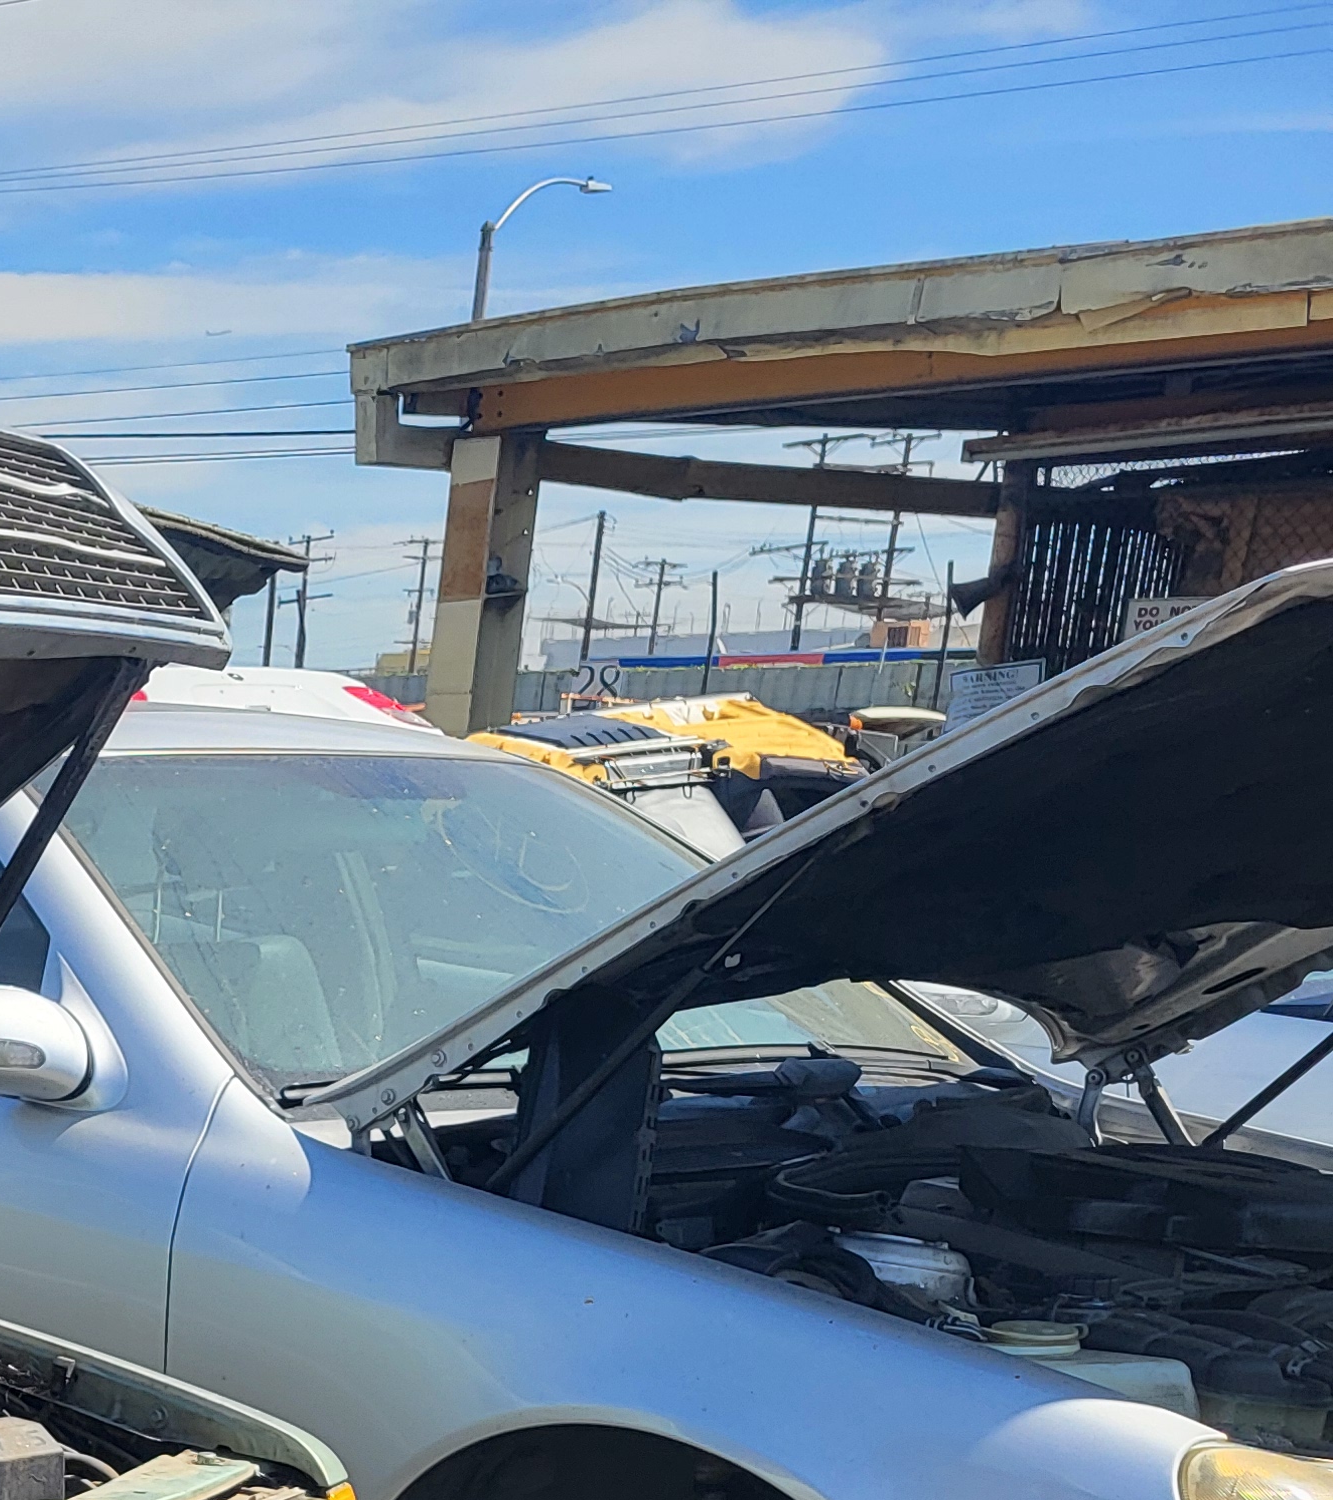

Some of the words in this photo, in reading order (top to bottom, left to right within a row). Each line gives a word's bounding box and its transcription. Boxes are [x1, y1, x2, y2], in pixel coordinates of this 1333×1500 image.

[1137, 606, 1160, 618] DO
[1169, 605, 1197, 617] NO
[578, 664, 620, 698] 28
